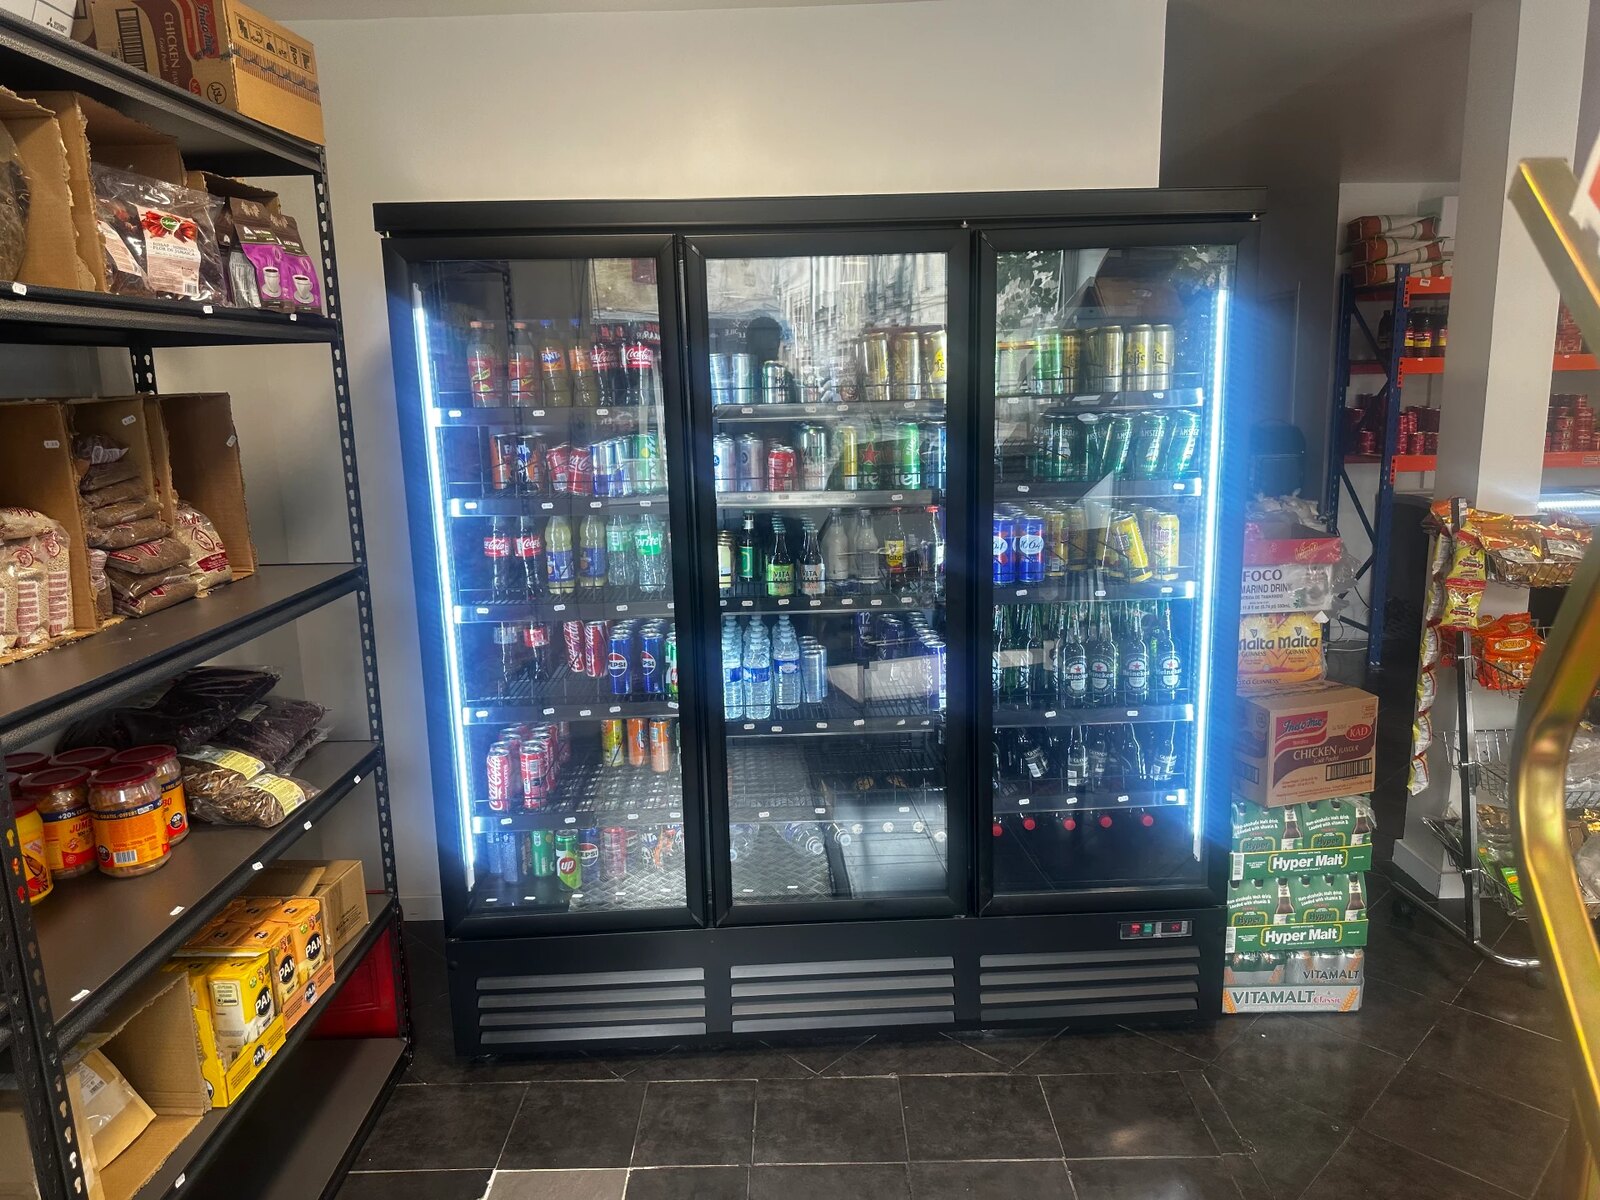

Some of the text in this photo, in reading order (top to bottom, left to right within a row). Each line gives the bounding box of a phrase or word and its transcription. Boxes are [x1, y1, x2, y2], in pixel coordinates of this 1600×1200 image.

[164, 12, 181, 69] CHICKEN
[1242, 569, 1283, 582] FOCO
[1241, 584, 1269, 594] MARIND
[1278, 635, 1319, 649] Malta
[1350, 726, 1368, 738] KAD
[1293, 745, 1338, 761] CHICKEN
[1272, 856, 1313, 871] Hyper
[1314, 854, 1344, 867] Malt
[1265, 930, 1307, 946] Hyper
[1308, 928, 1338, 940] Malt
[1303, 969, 1360, 981] VITAMALT
[1232, 990, 1341, 1004] VITAMALT Classic
